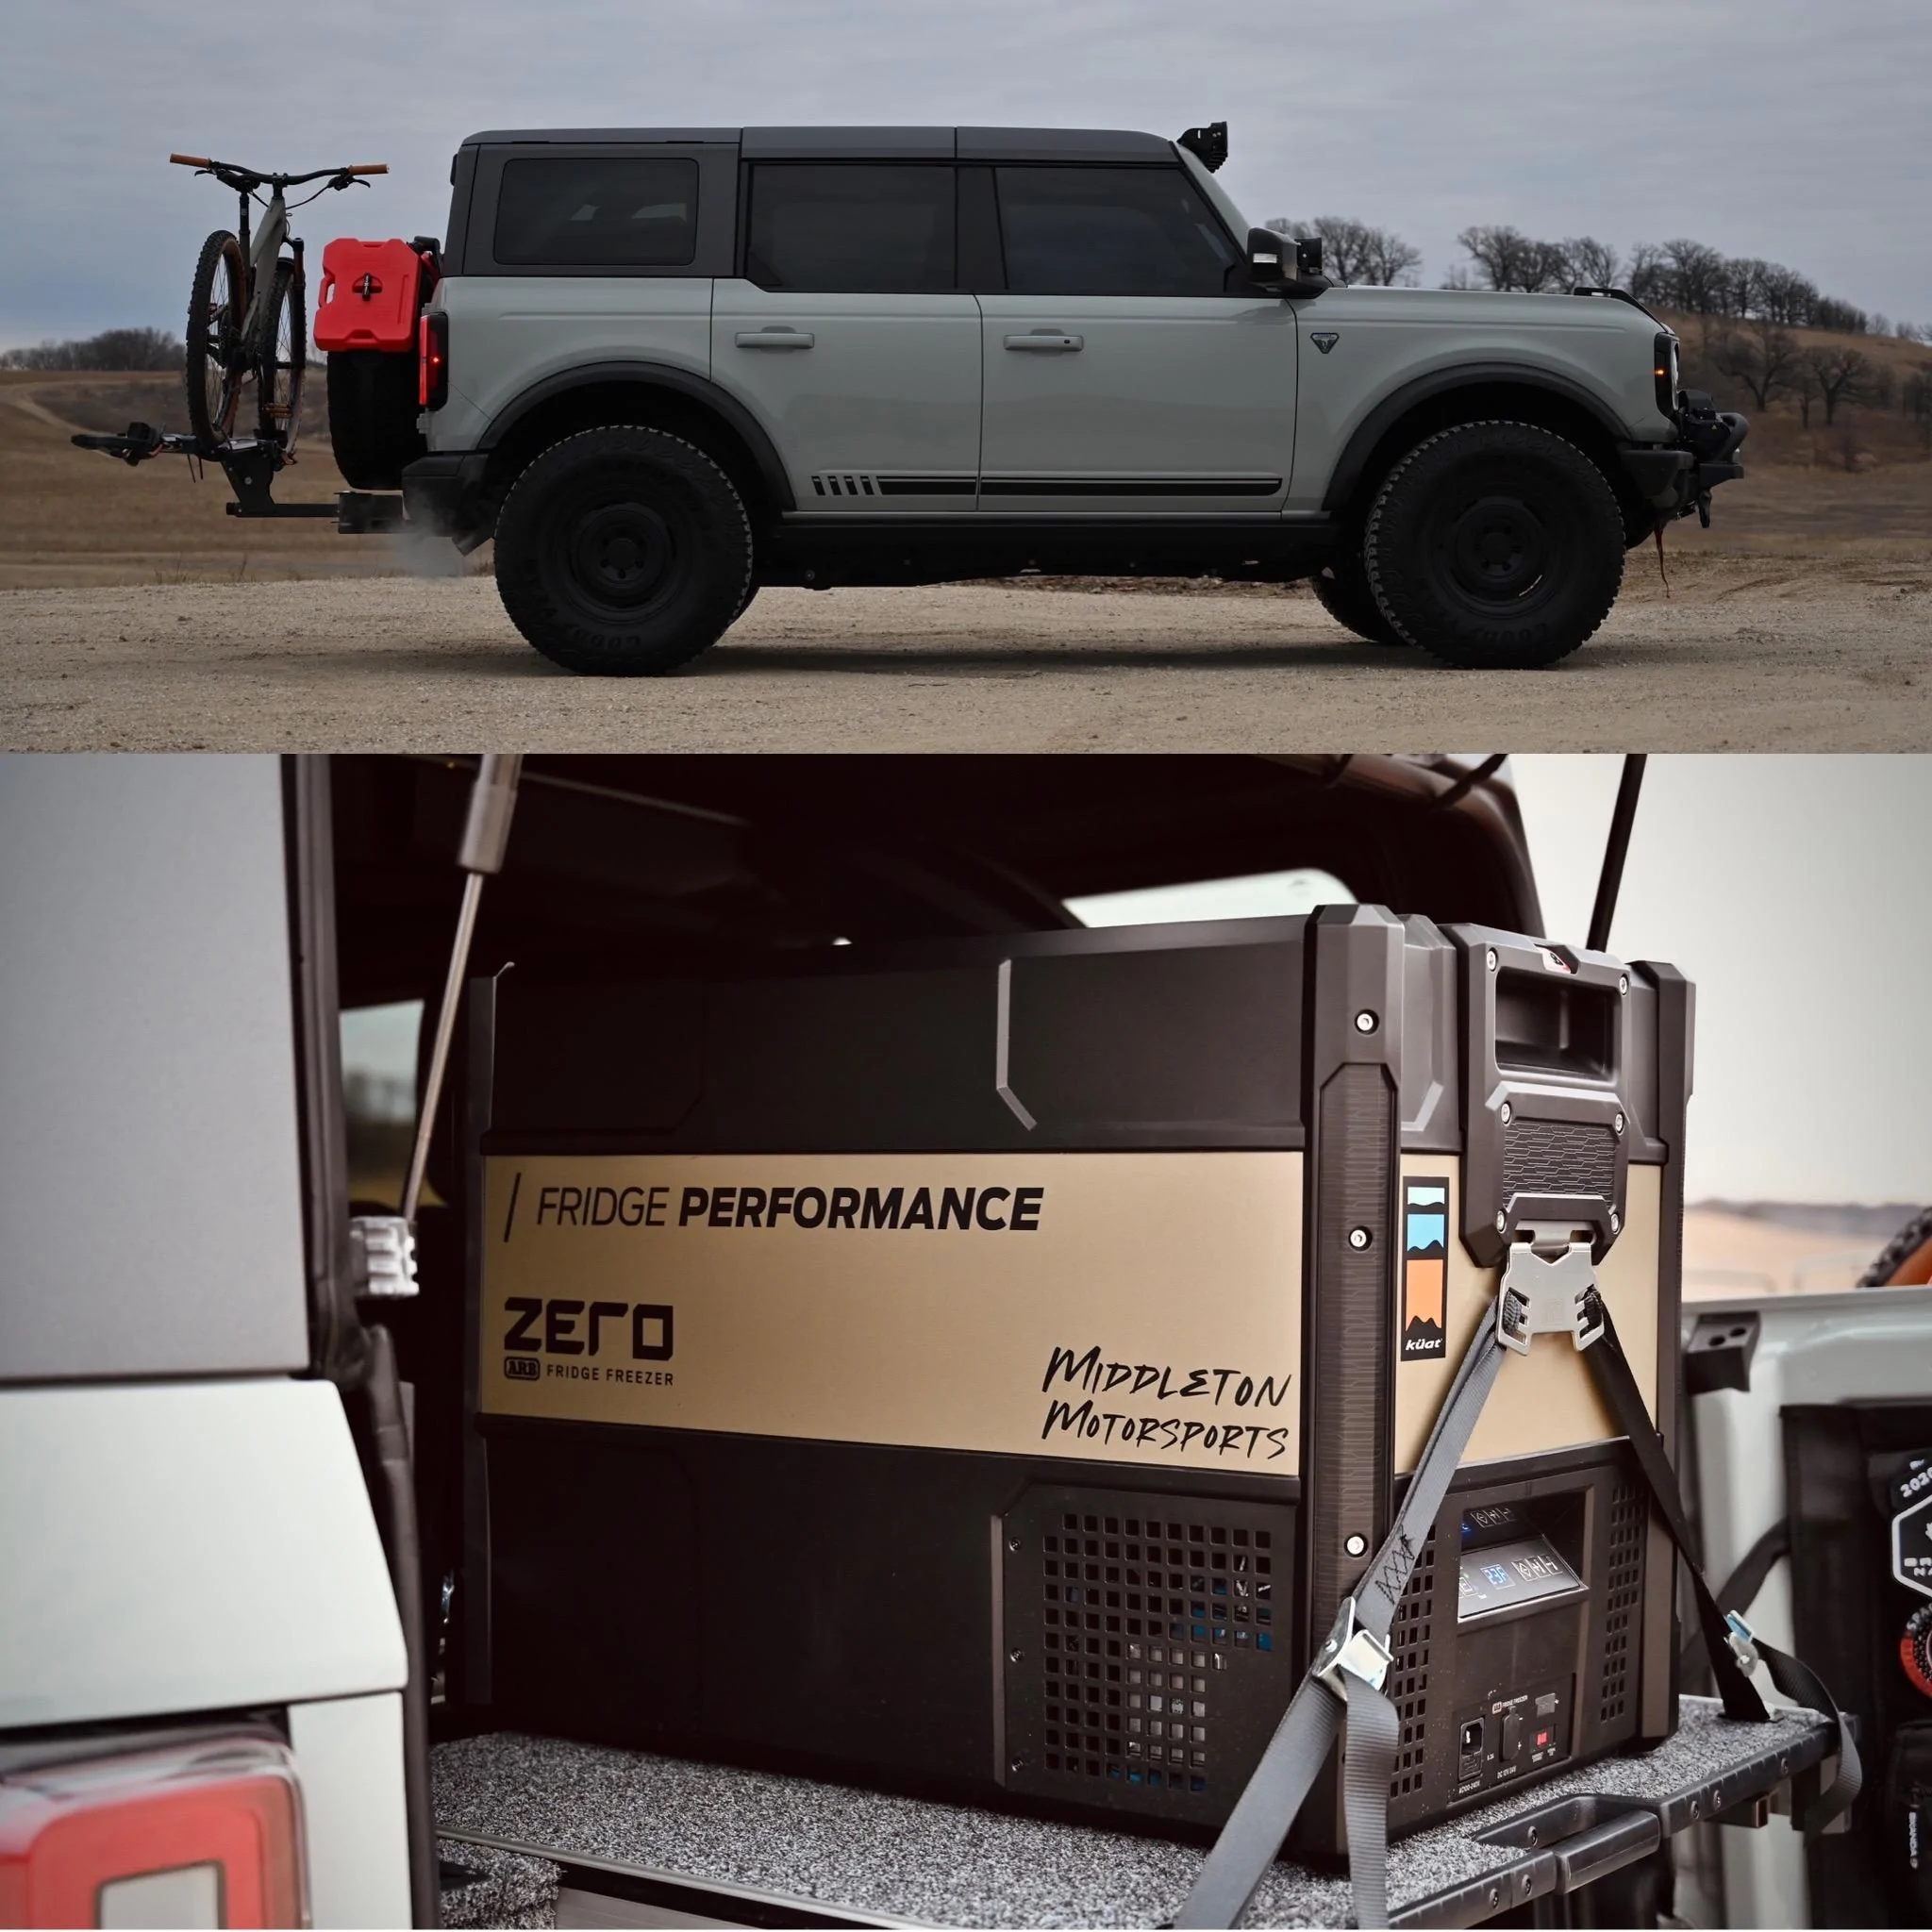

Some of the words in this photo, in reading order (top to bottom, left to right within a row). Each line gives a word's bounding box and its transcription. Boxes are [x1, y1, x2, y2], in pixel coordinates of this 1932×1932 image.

[537, 1187, 670, 1226] FRIDGE
[678, 1187, 1044, 1231] PERFORMANCE
[1405, 1338, 1441, 1351] küat
[546, 1364, 600, 1381] FRIDGE
[606, 1369, 674, 1386] FREEZER
